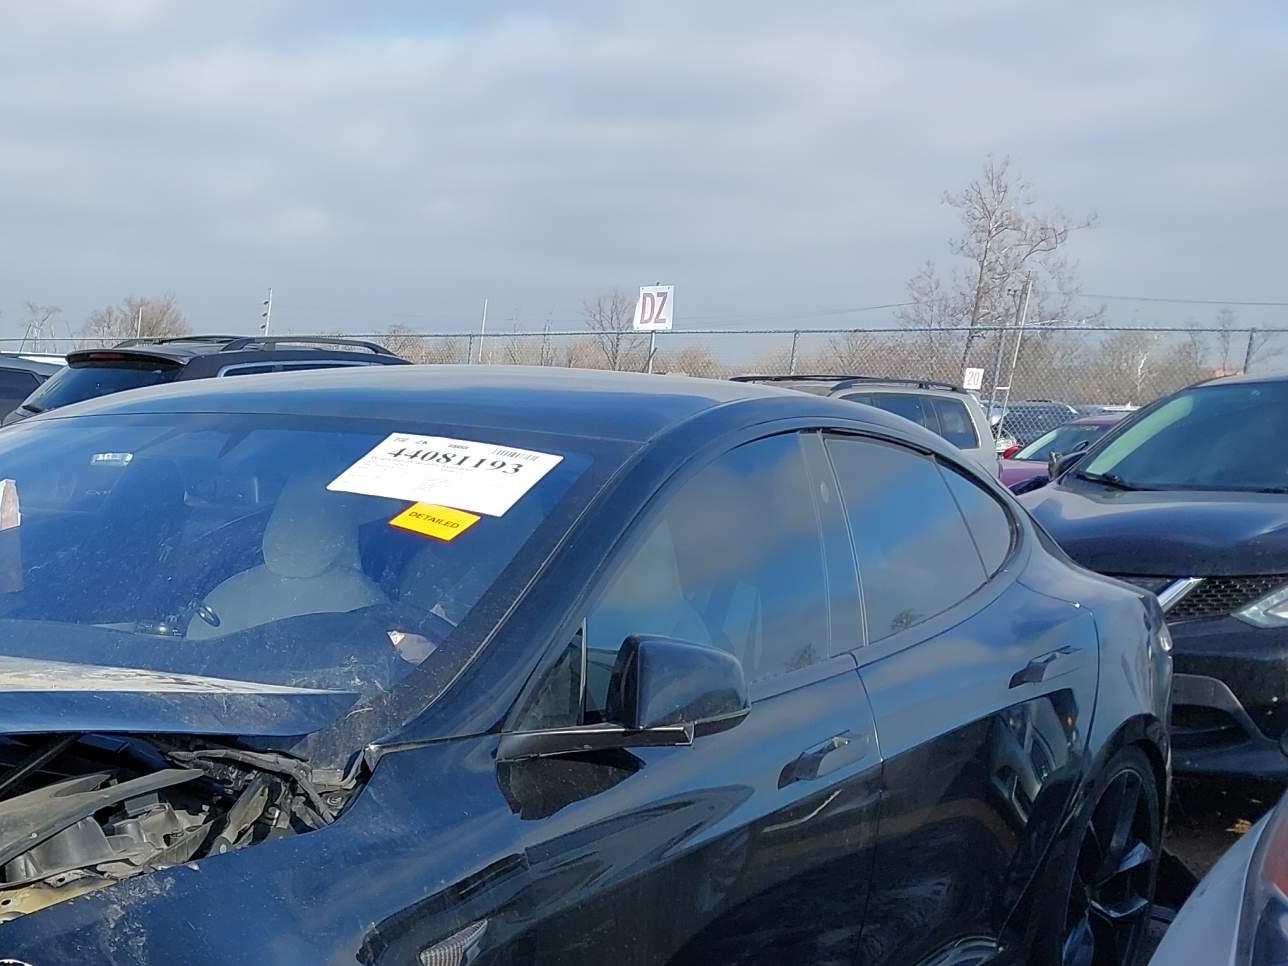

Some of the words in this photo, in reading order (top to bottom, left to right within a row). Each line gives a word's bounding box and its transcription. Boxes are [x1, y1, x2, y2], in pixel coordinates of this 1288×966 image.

[640, 292, 668, 324] DZ
[387, 447, 524, 475] 44081193
[408, 510, 460, 530] DETAILED
